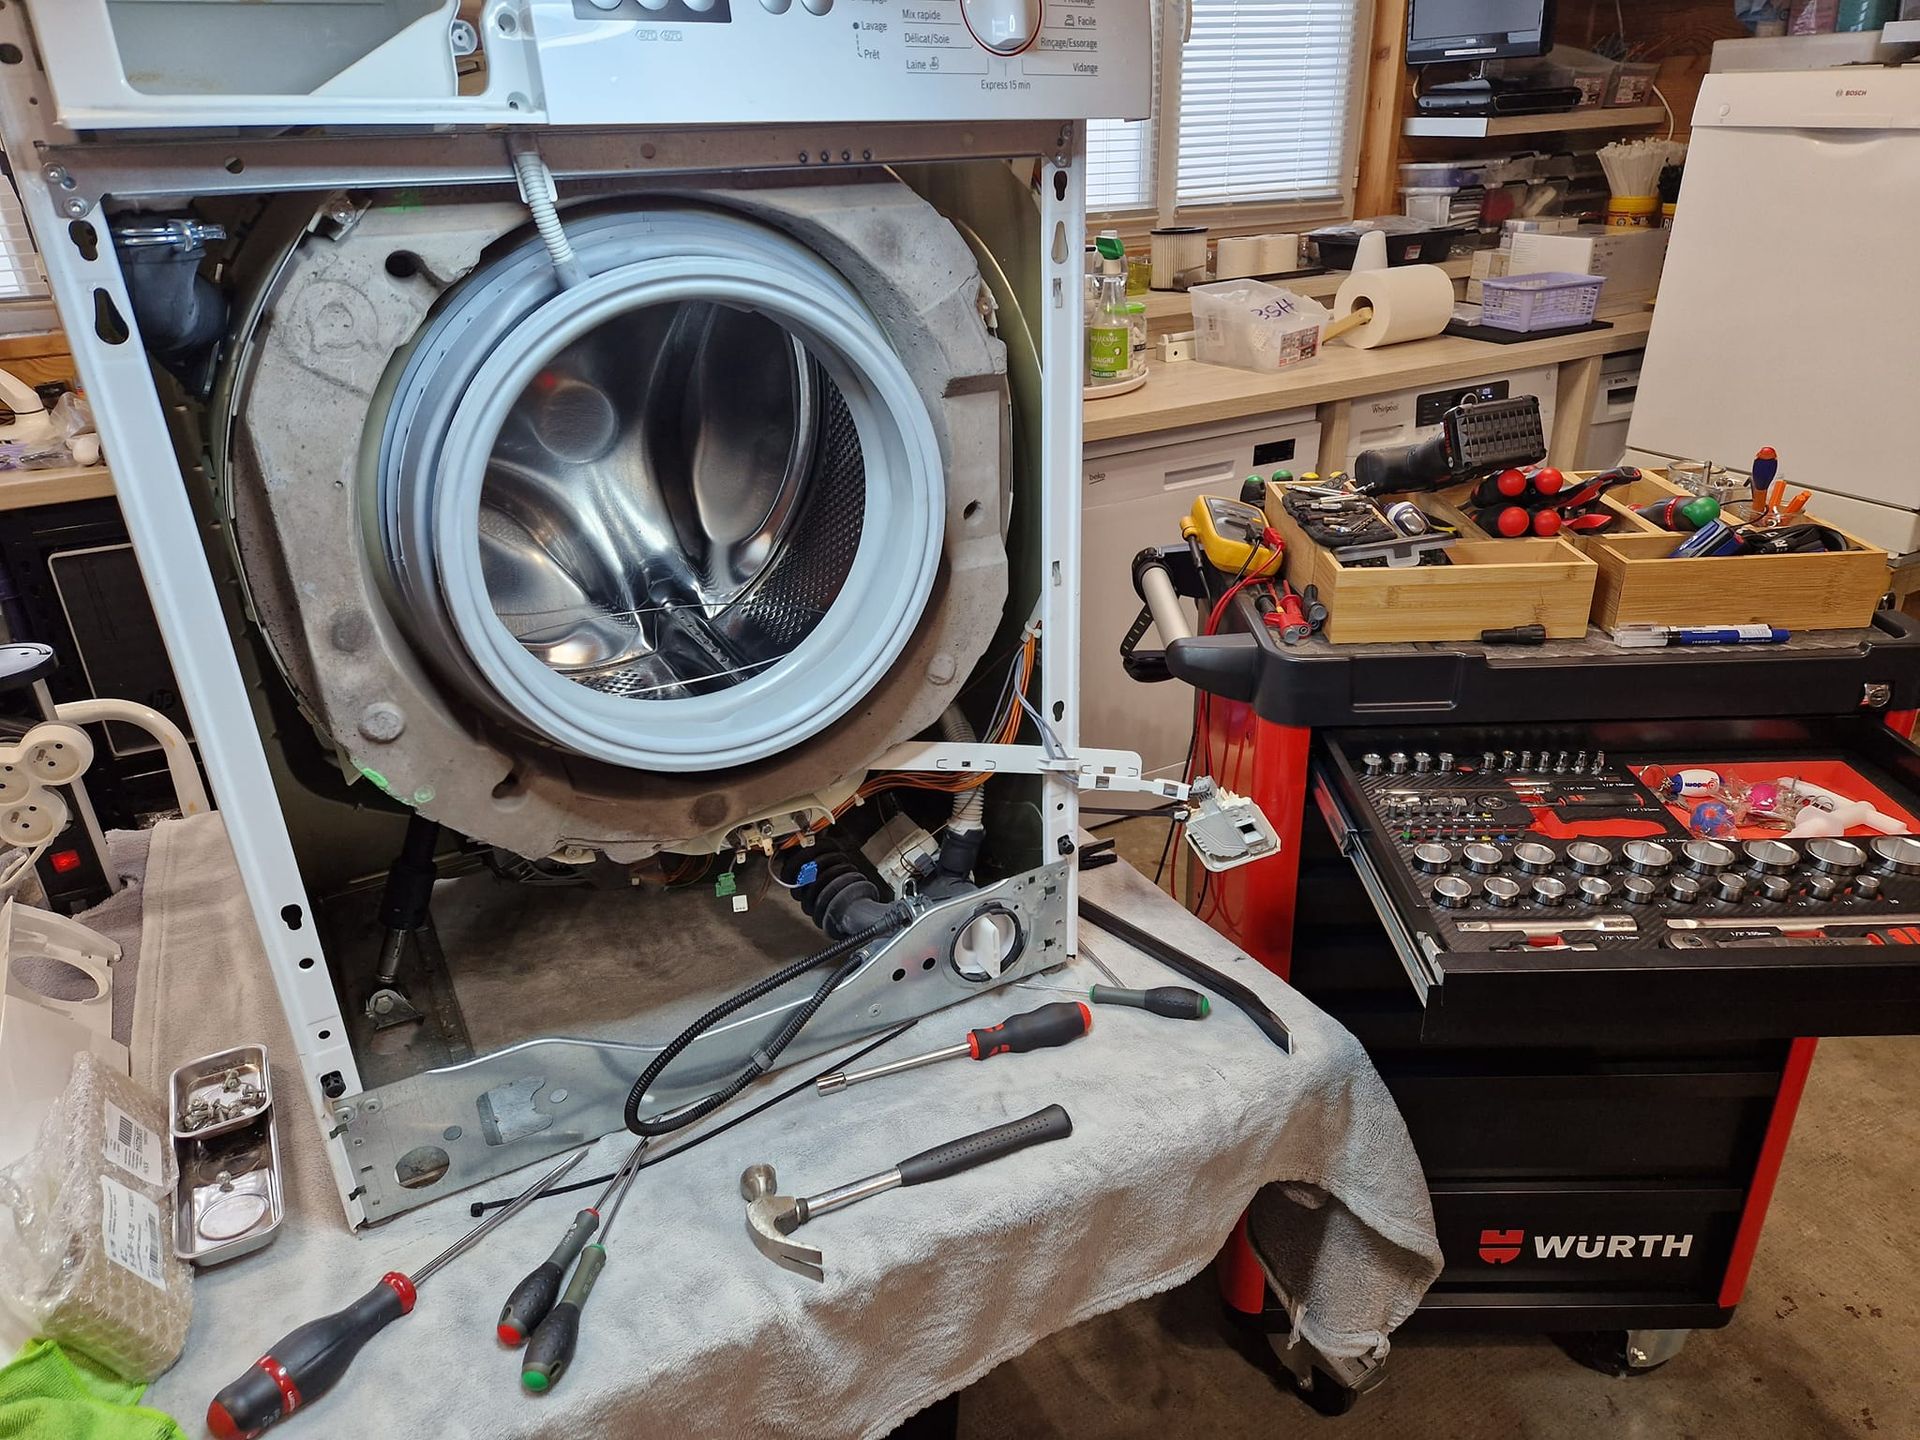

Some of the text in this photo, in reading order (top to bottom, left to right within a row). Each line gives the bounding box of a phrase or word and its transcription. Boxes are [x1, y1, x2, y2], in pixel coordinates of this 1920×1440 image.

[902, 9, 941, 22] Mix rapide
[1078, 16, 1096, 26] Facile
[861, 21, 887, 33] Lavage
[905, 32, 950, 44] Délicat/Soie
[1040, 38, 1098, 49] Rinçage/Essorage
[864, 49, 880, 60] Prêt
[906, 59, 926, 70] Laine
[1073, 63, 1098, 74] Vidange
[981, 79, 1031, 91] Express 15 min
[1371, 402, 1400, 415] Whirlpool
[1089, 472, 1106, 481] beko
[1533, 1234, 1694, 1259] WÜRTH
